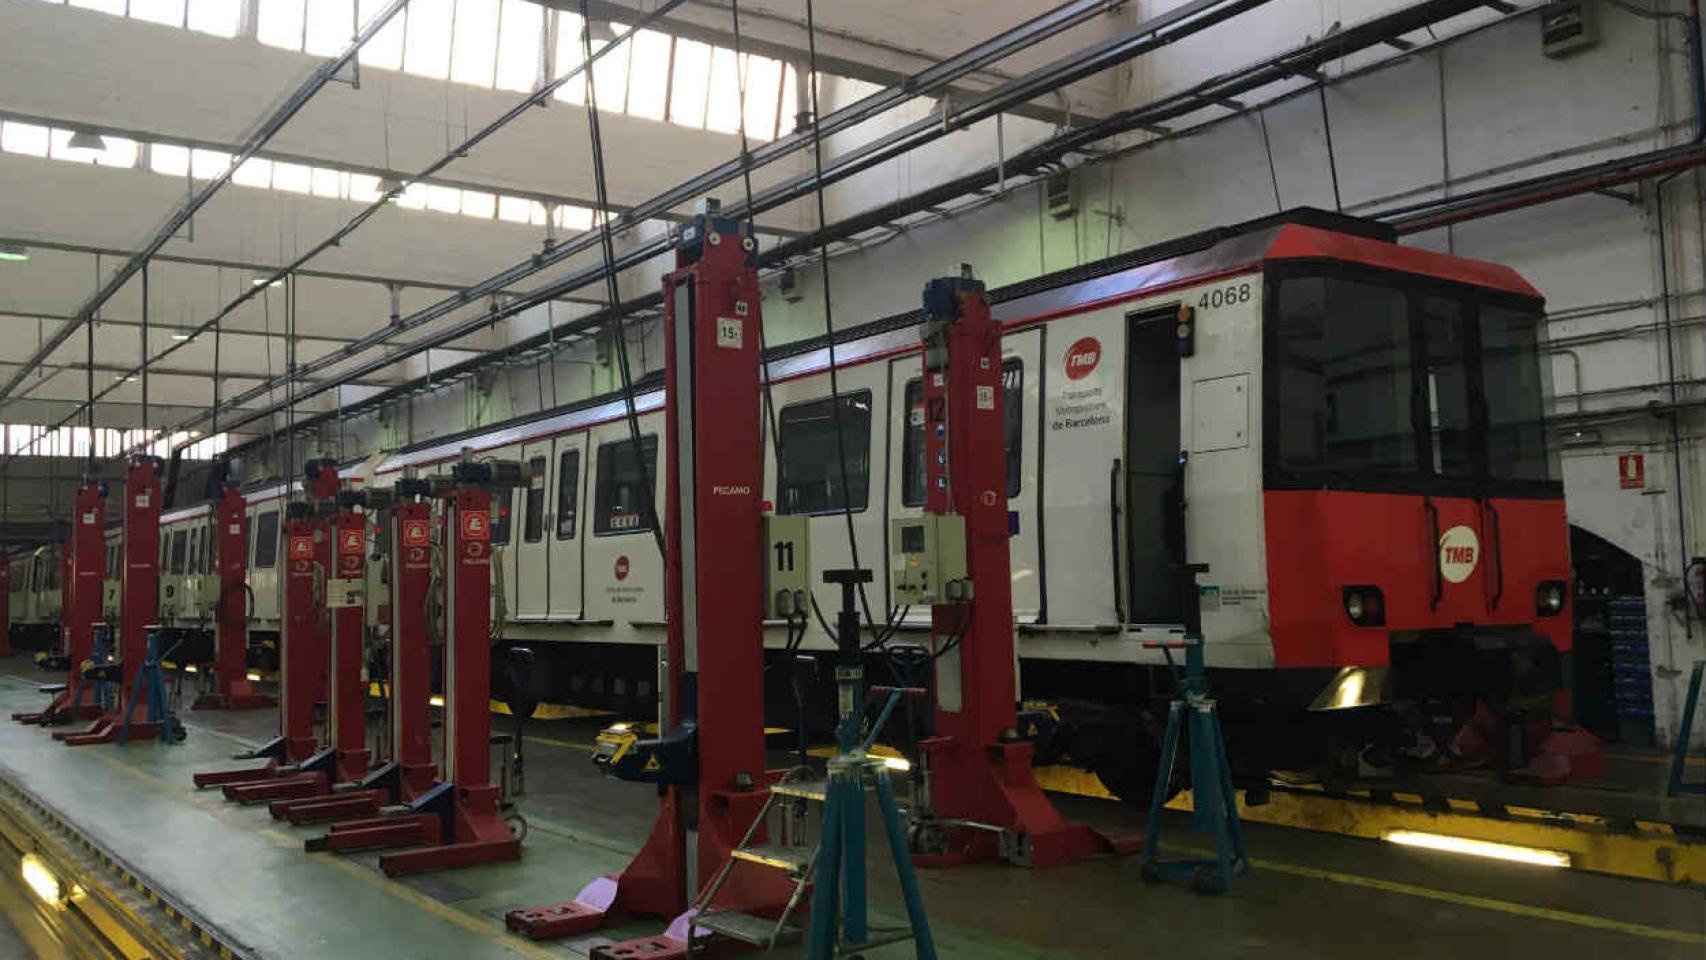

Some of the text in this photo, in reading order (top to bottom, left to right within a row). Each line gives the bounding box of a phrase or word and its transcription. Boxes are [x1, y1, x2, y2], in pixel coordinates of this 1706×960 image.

[1198, 283, 1251, 311] 4068
[1070, 350, 1097, 367] TMB
[928, 398, 945, 421] 12
[1065, 415, 1111, 429] Barcelona
[774, 541, 794, 571] 11
[1445, 546, 1474, 564] TMB
[165, 586, 175, 598] 9
